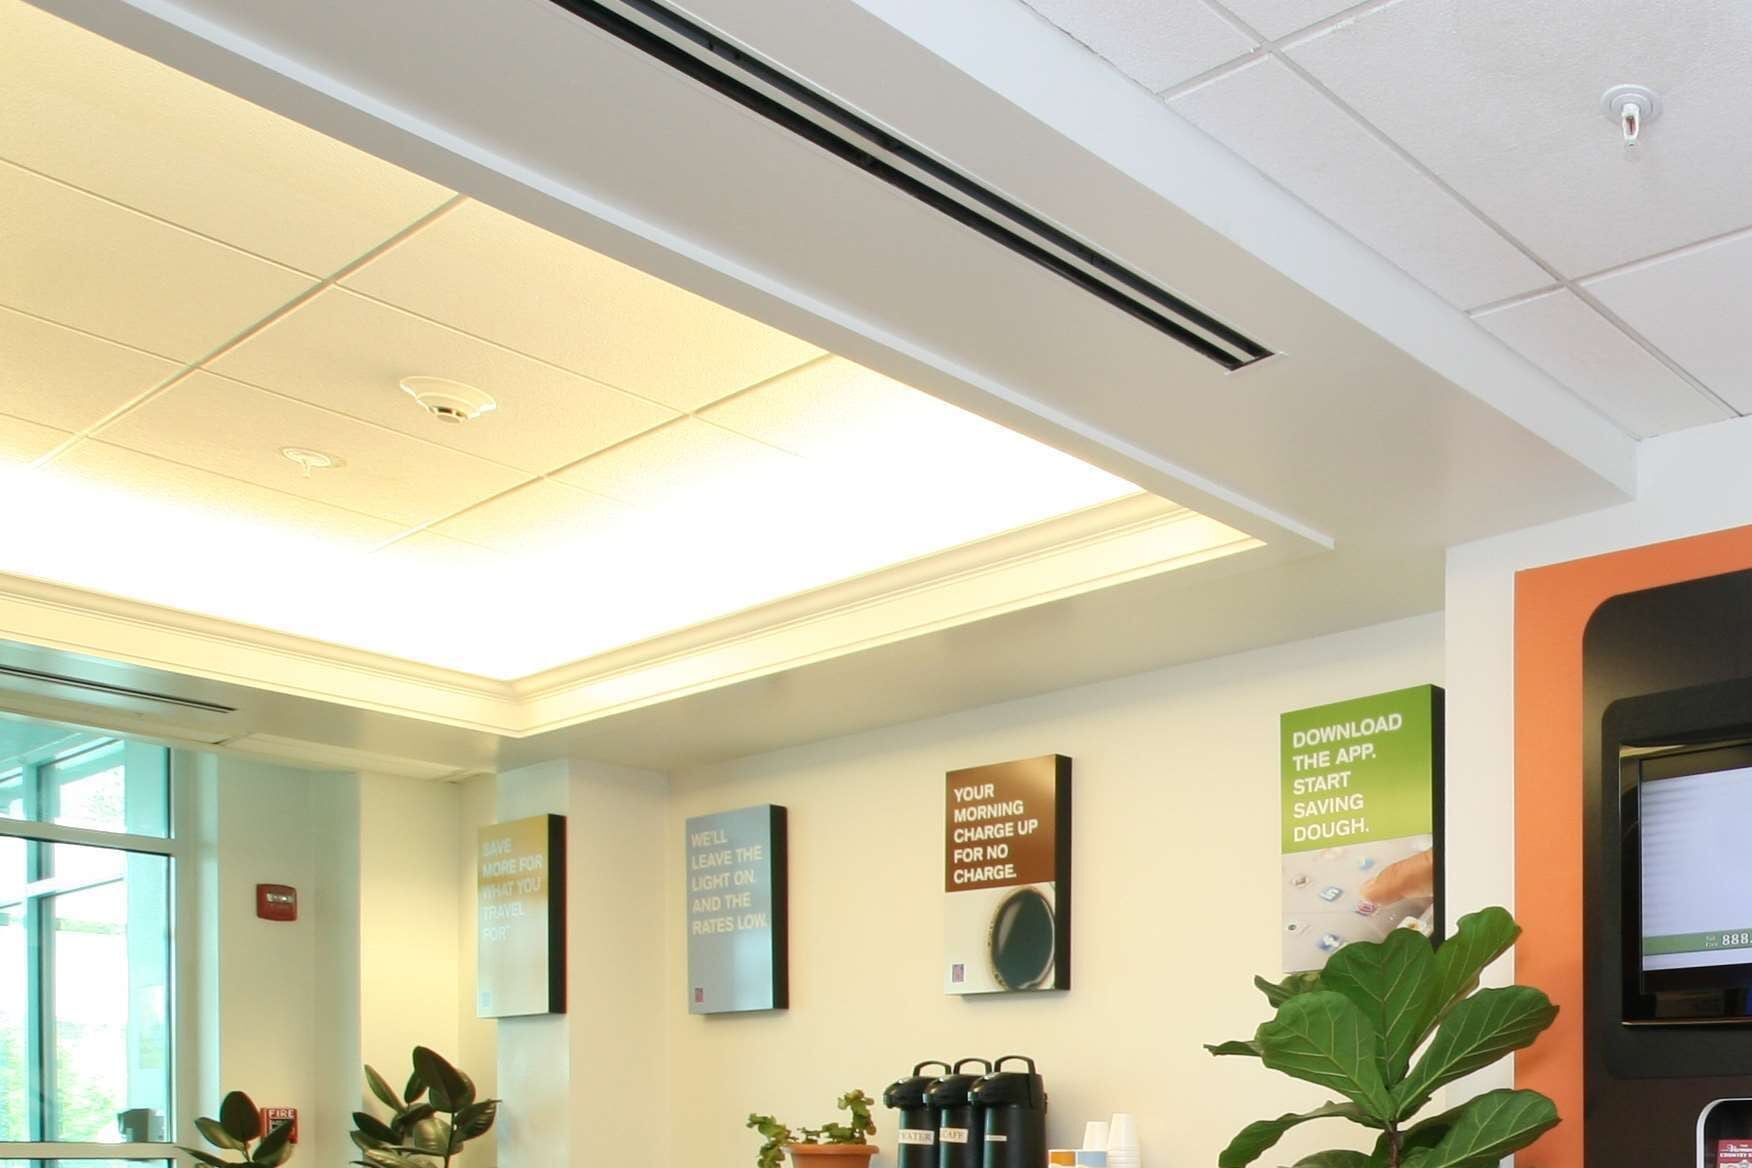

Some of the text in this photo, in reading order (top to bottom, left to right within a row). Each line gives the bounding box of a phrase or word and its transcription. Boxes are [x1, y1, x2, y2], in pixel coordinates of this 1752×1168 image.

[1293, 713, 1402, 748] DOWNLOAD
[1292, 743, 1376, 771] THE APP.
[953, 784, 995, 802] YOUR
[1293, 771, 1351, 795] START
[953, 800, 1024, 823] MORNING
[1293, 793, 1364, 818] SAVING
[691, 830, 728, 848] WE'LL
[953, 819, 1038, 843] CHARGE UP
[1294, 818, 1370, 842] DOUGH.
[483, 837, 512, 856] SAVE
[691, 845, 763, 870] LEAVE THE
[953, 844, 1008, 864] FOR NO
[483, 854, 543, 878] MORE FOR
[953, 864, 1017, 884] CHARGE.
[483, 876, 541, 899] WHAT YOU
[691, 872, 730, 891] LIGHT
[692, 892, 751, 913] AND THE
[692, 916, 734, 936] RATES
[269, 1109, 295, 1119] FIRE
